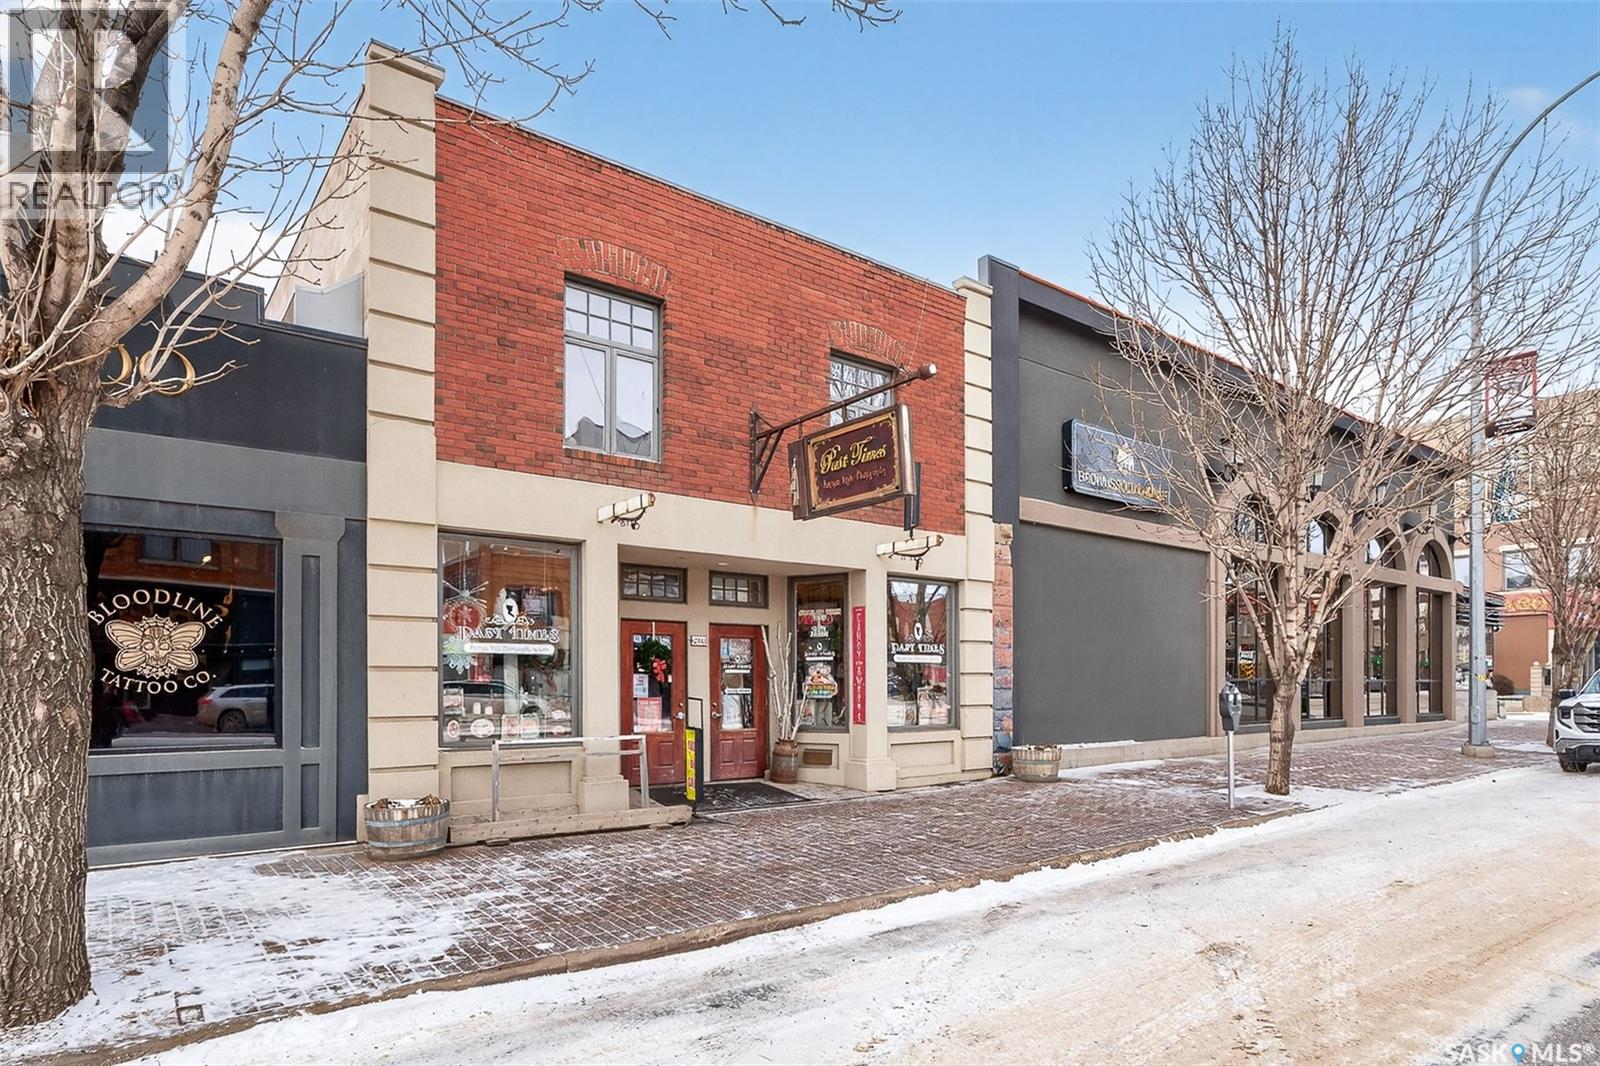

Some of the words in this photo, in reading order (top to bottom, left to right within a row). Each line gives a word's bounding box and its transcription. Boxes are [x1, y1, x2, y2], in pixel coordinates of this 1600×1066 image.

[820, 444, 849, 474] Past
[850, 436, 887, 466] Times
[88, 588, 223, 629] BLOODLINE
[100, 668, 179, 695] TATTOO
[184, 671, 217, 689] CO.
